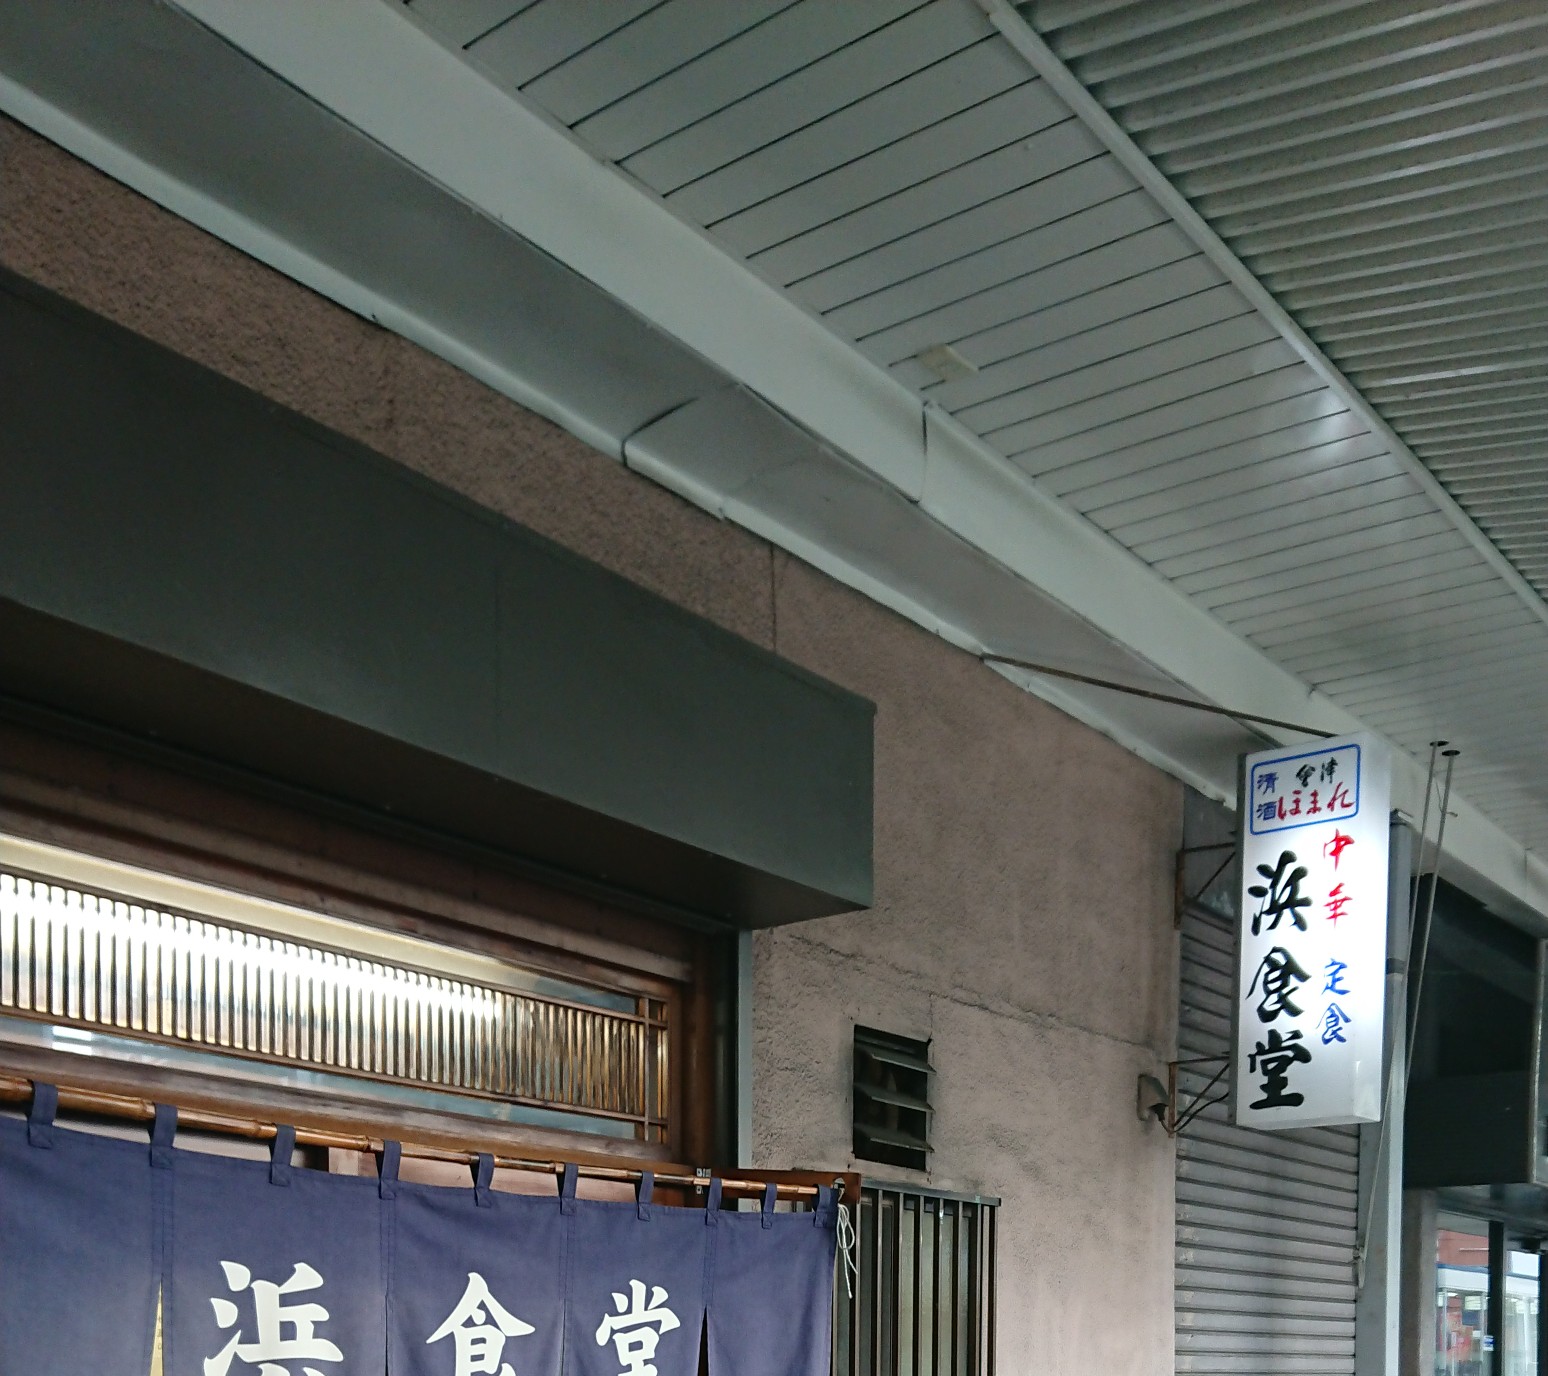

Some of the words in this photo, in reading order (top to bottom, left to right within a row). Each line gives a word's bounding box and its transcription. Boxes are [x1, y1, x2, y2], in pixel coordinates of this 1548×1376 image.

[1256, 772, 1279, 821] 清酒
[1277, 781, 1356, 821] ほまれ
[1322, 828, 1356, 930] 中華
[1246, 849, 1314, 1111] 浜食堂
[1315, 957, 1353, 1046] 定食
